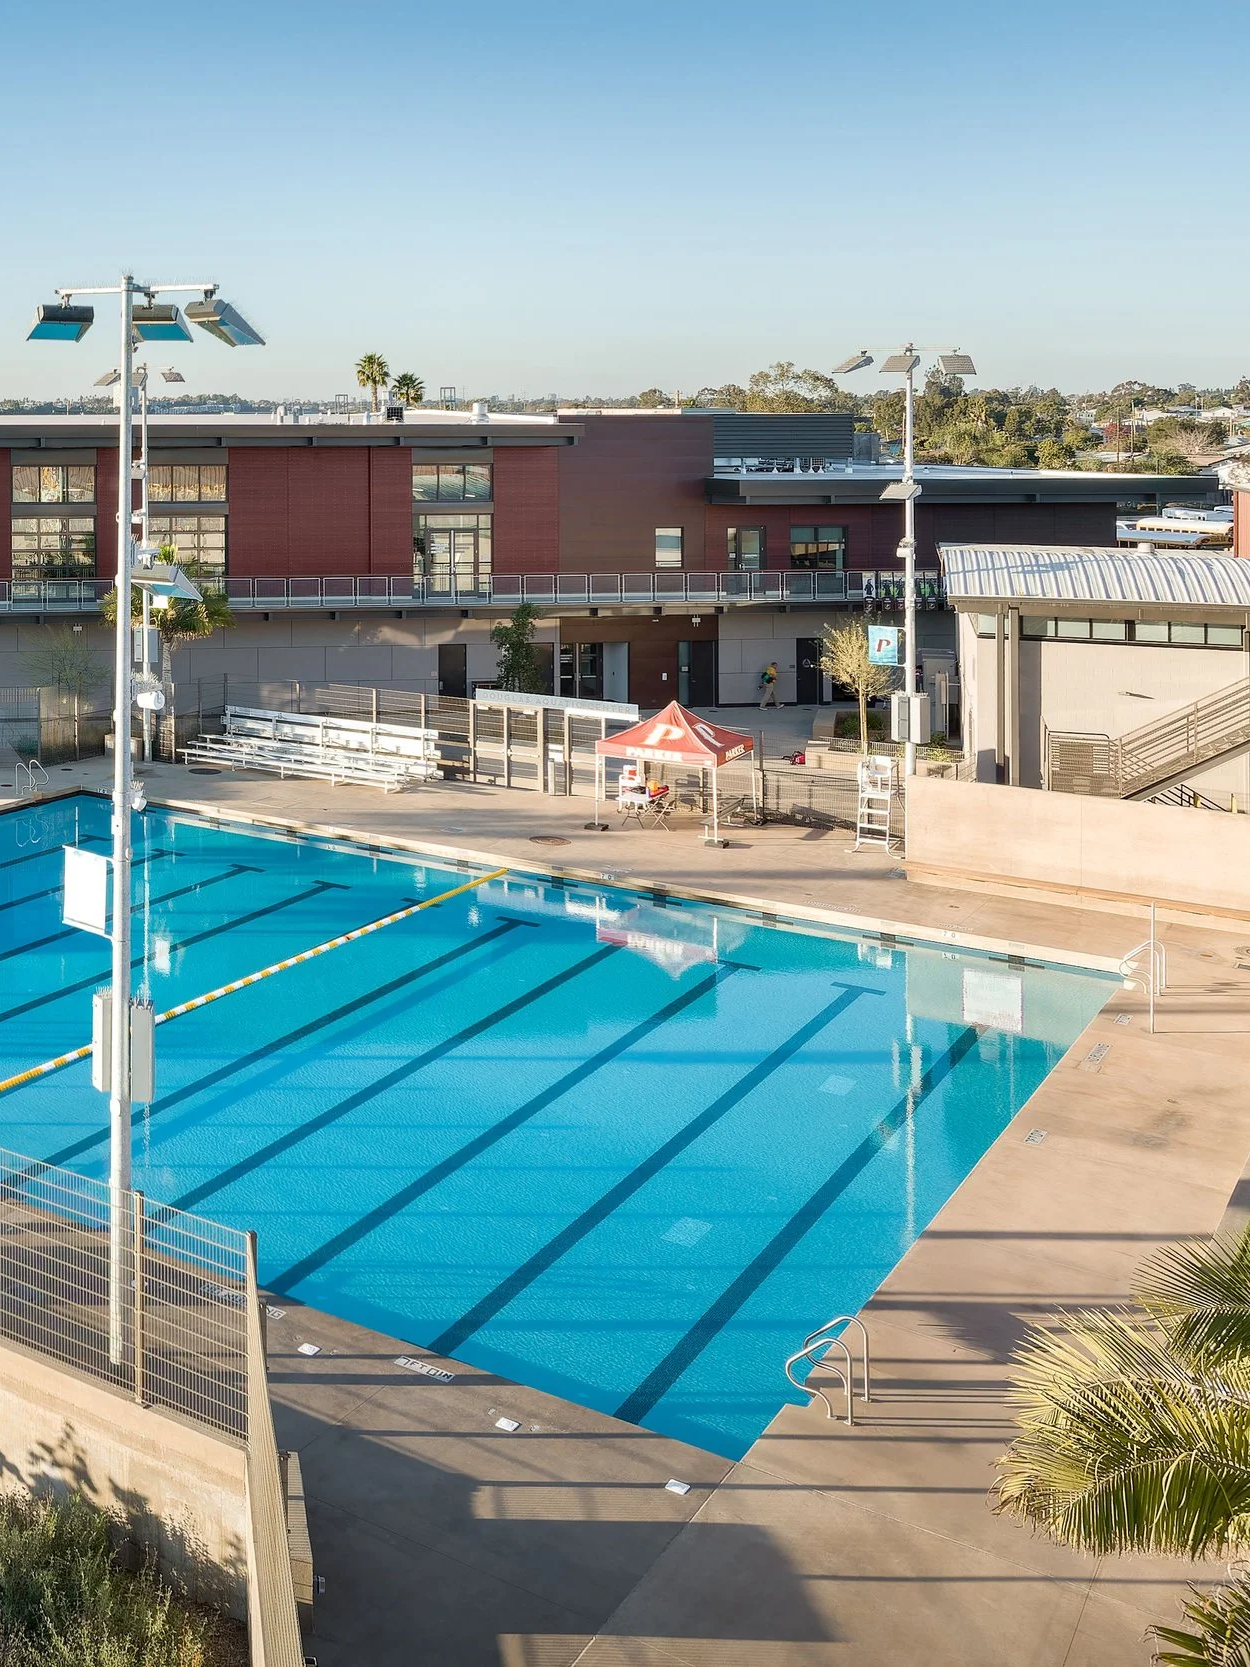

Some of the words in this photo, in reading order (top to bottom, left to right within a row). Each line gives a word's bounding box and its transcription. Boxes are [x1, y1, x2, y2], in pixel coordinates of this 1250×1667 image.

[876, 638, 892, 653] P
[482, 692, 531, 704] DOUGLAS
[640, 722, 686, 746] P
[626, 746, 683, 762] PARKER
[725, 743, 746, 761] PARKER
